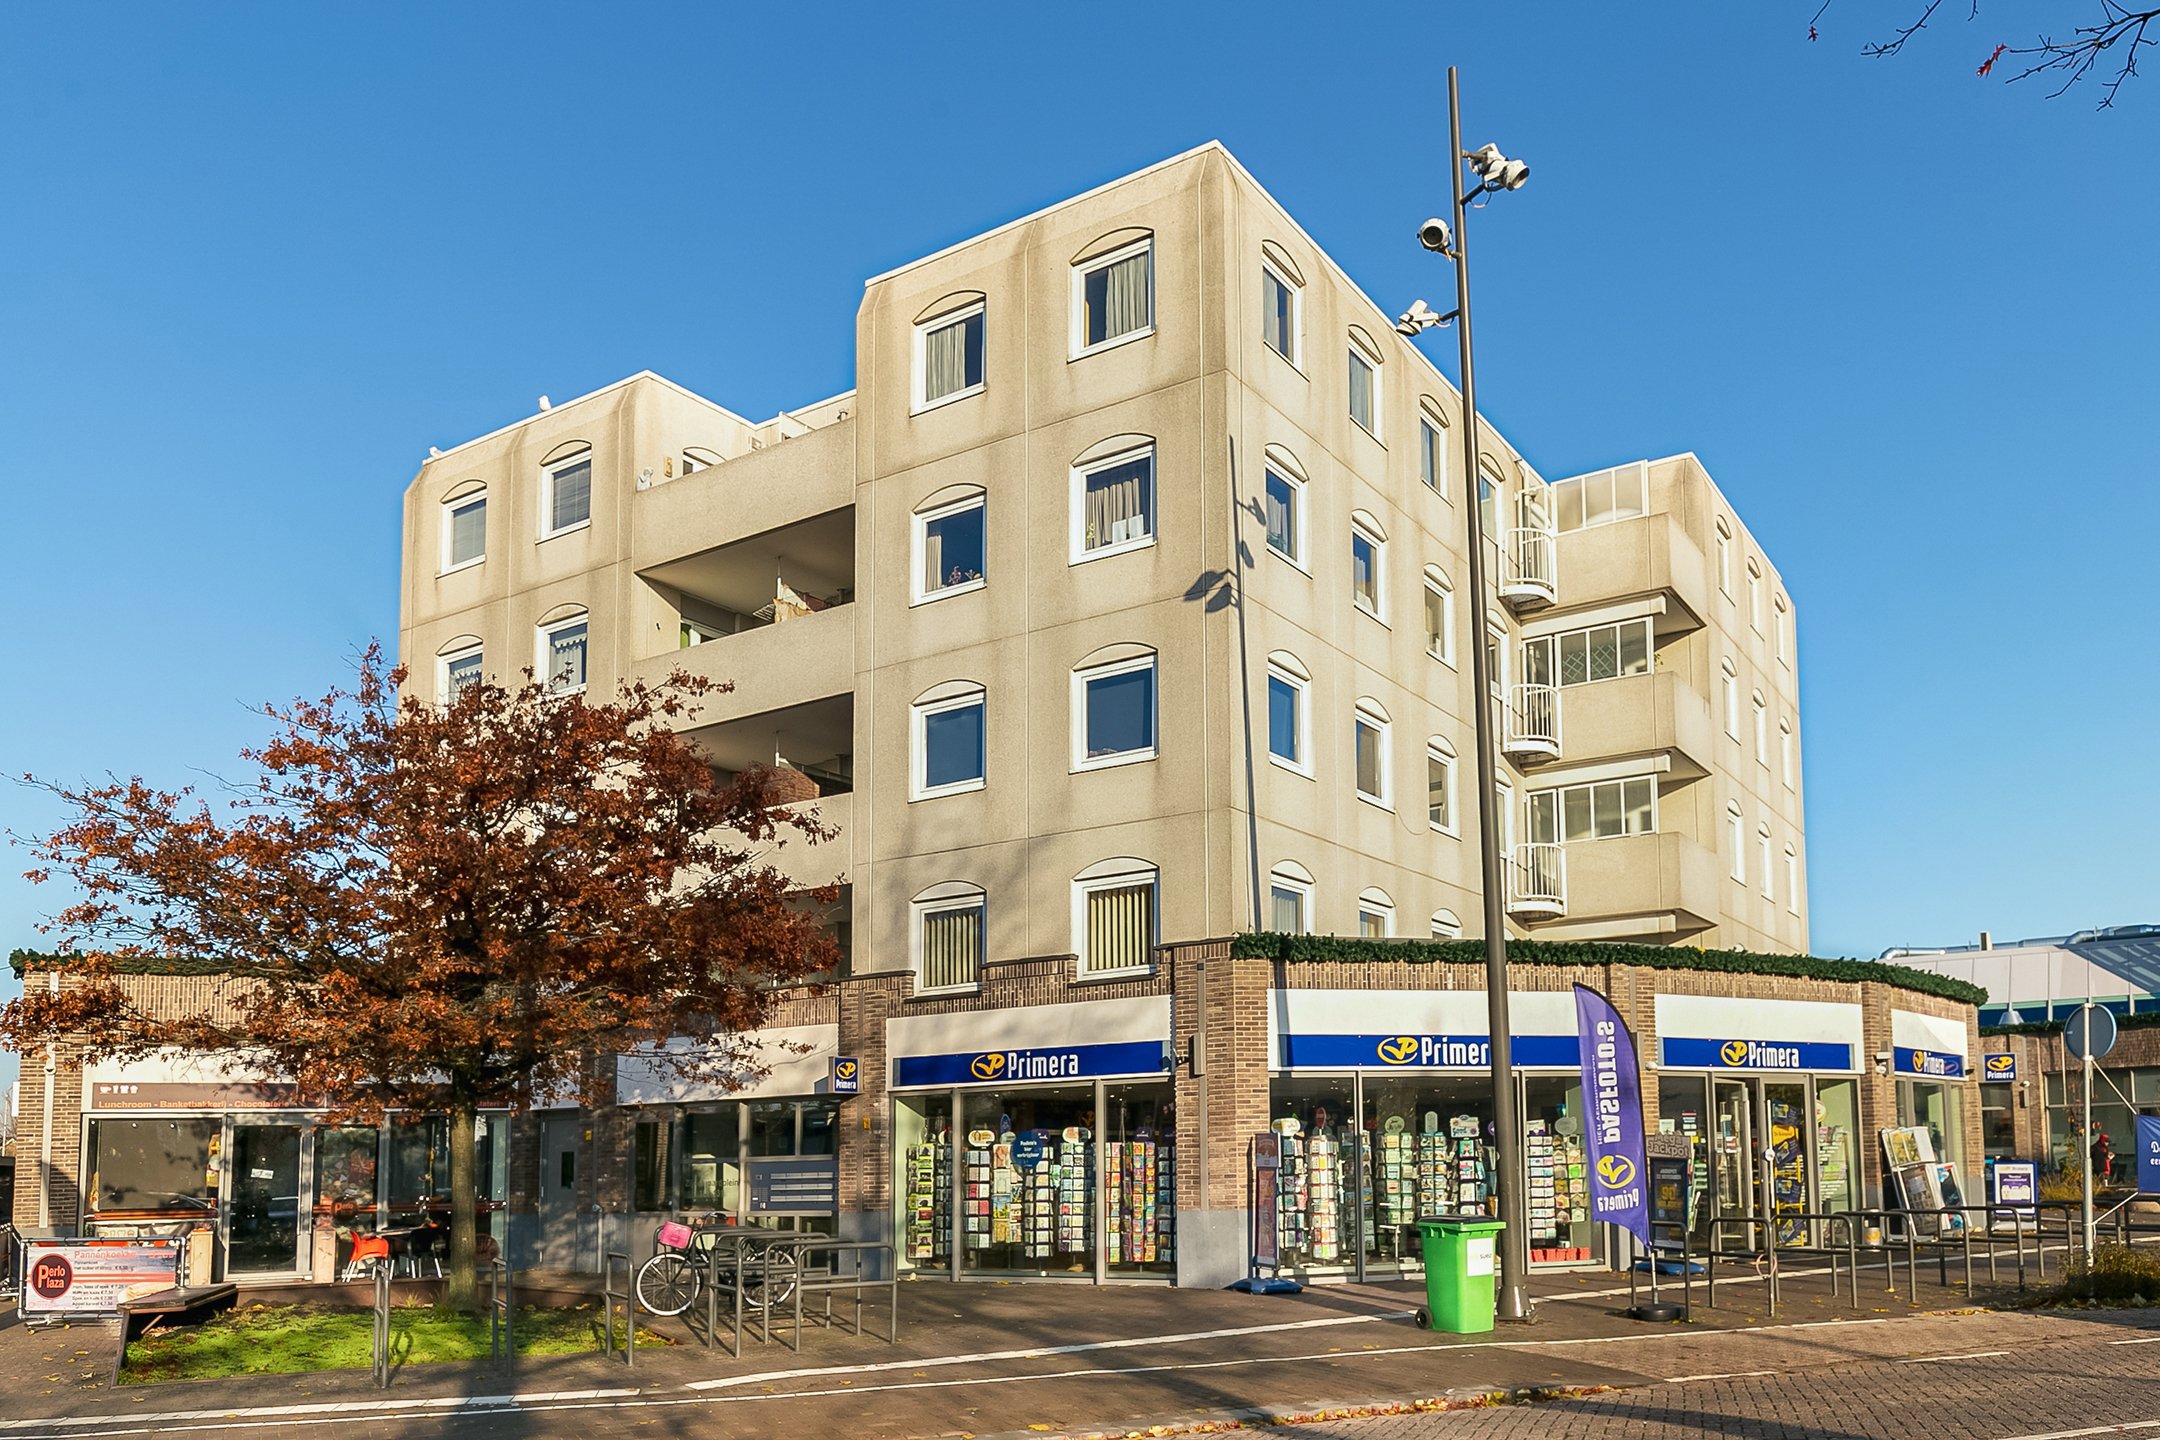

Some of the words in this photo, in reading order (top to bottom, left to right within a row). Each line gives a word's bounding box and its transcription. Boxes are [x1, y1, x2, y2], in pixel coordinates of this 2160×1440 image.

[1421, 1036, 1489, 1065] Primer
[1748, 1041, 1800, 1067] Primera
[1008, 1051, 1079, 1079] Primera
[1923, 1051, 1945, 1075] Primera
[836, 1079, 857, 1090] Primera
[1987, 1071, 2015, 1080] Primera
[98, 1100, 152, 1109] Lunchroom
[160, 1100, 227, 1109] Banketbakkerij
[1648, 1141, 1689, 1157] Jackpot
[38, 1265, 66, 1288] Perlo
